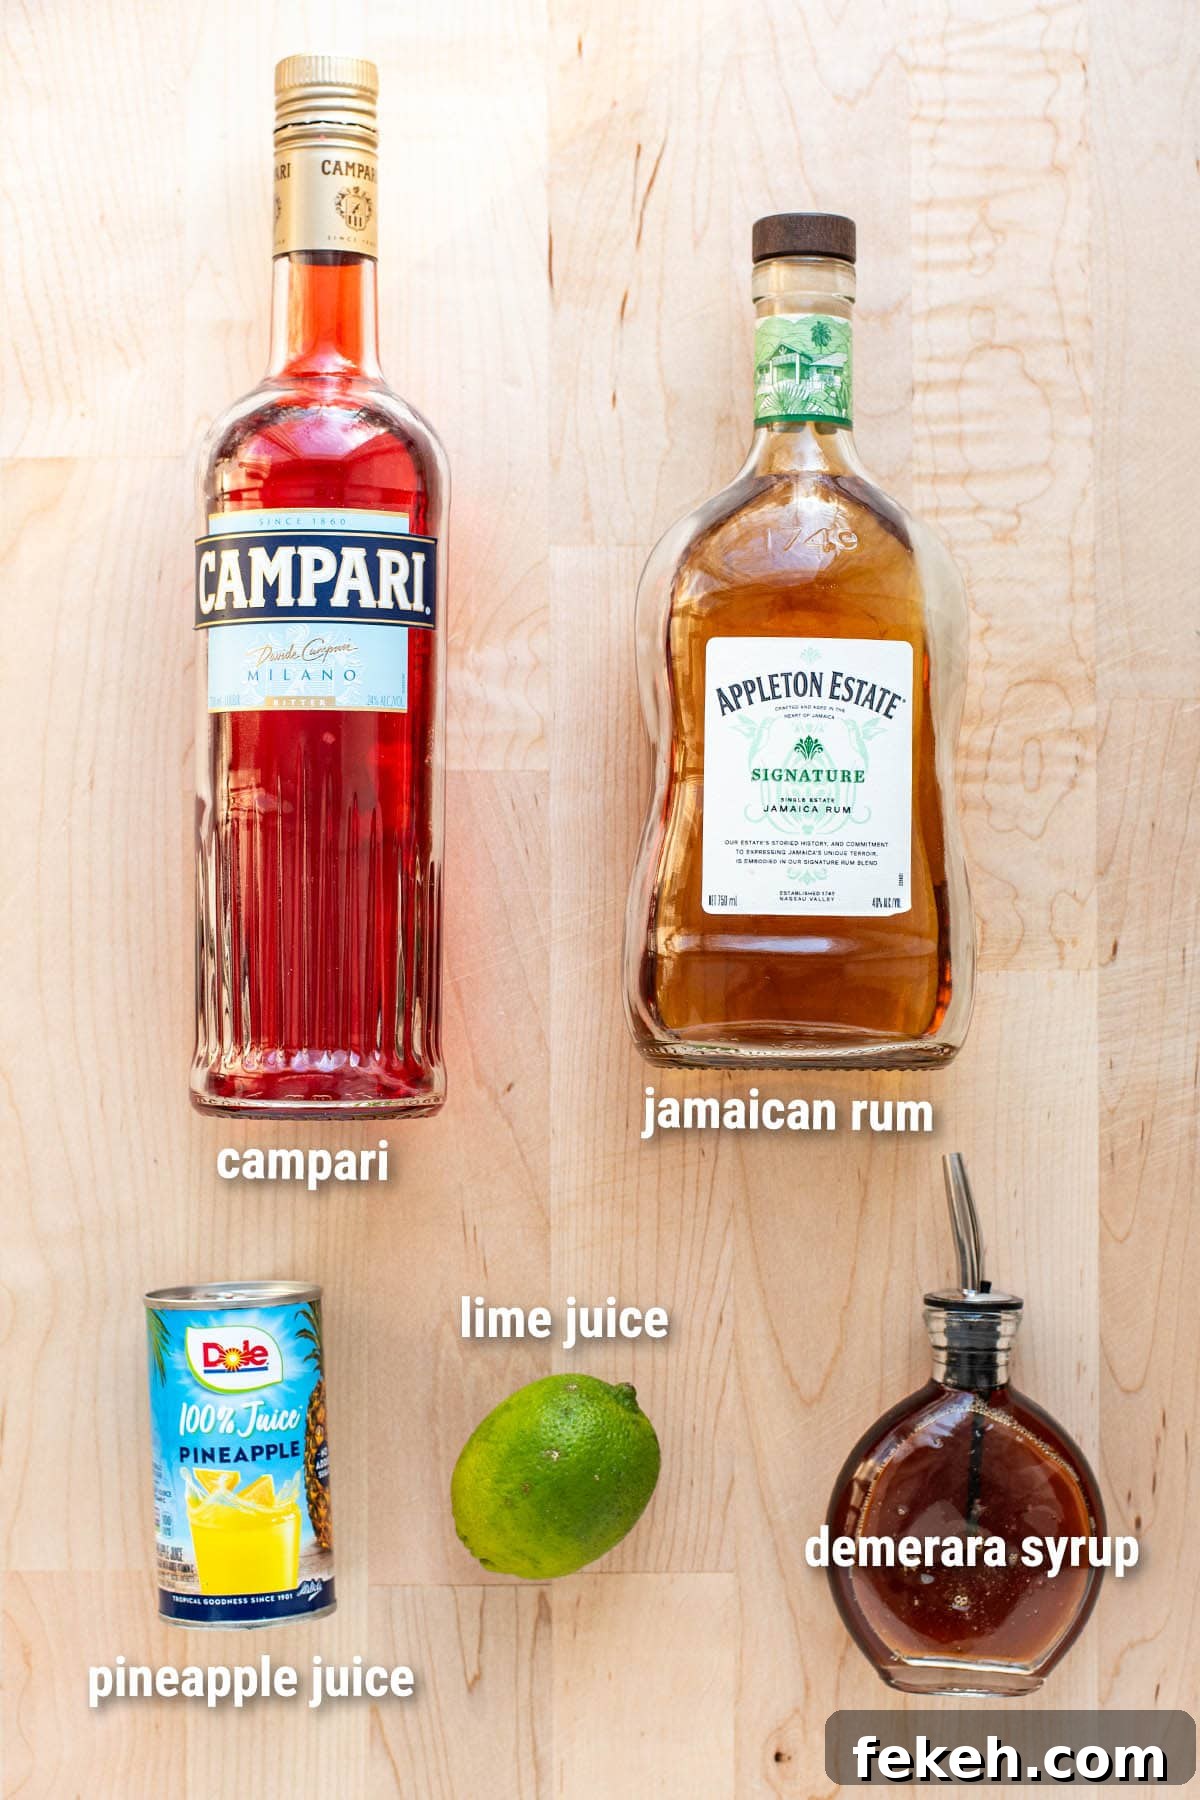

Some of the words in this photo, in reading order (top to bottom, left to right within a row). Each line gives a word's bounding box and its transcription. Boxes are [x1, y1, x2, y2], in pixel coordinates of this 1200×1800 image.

[258, 518, 302, 527] SINCE
[312, 518, 346, 527] 1860
[247, 669, 357, 681] MILANO
[715, 671, 824, 717] APPLETON
[272, 698, 326, 707] BITTER
[774, 704, 799, 712] CRAFTED
[751, 768, 865, 783] SIGNATURE
[763, 805, 819, 813] JAMAICA
[825, 806, 851, 814] RUM
[717, 894, 728, 906] 750
[202, 1340, 269, 1372] Dole
[179, 1402, 236, 1436] 100%
[237, 1401, 300, 1438] Juice
[179, 1440, 301, 1464] PINEAPPLE
[172, 1595, 201, 1606] TROPICAL
[202, 1597, 248, 1606] GOODNESS
[250, 1595, 275, 1604] SINCE
[277, 1593, 293, 1601] 1901
